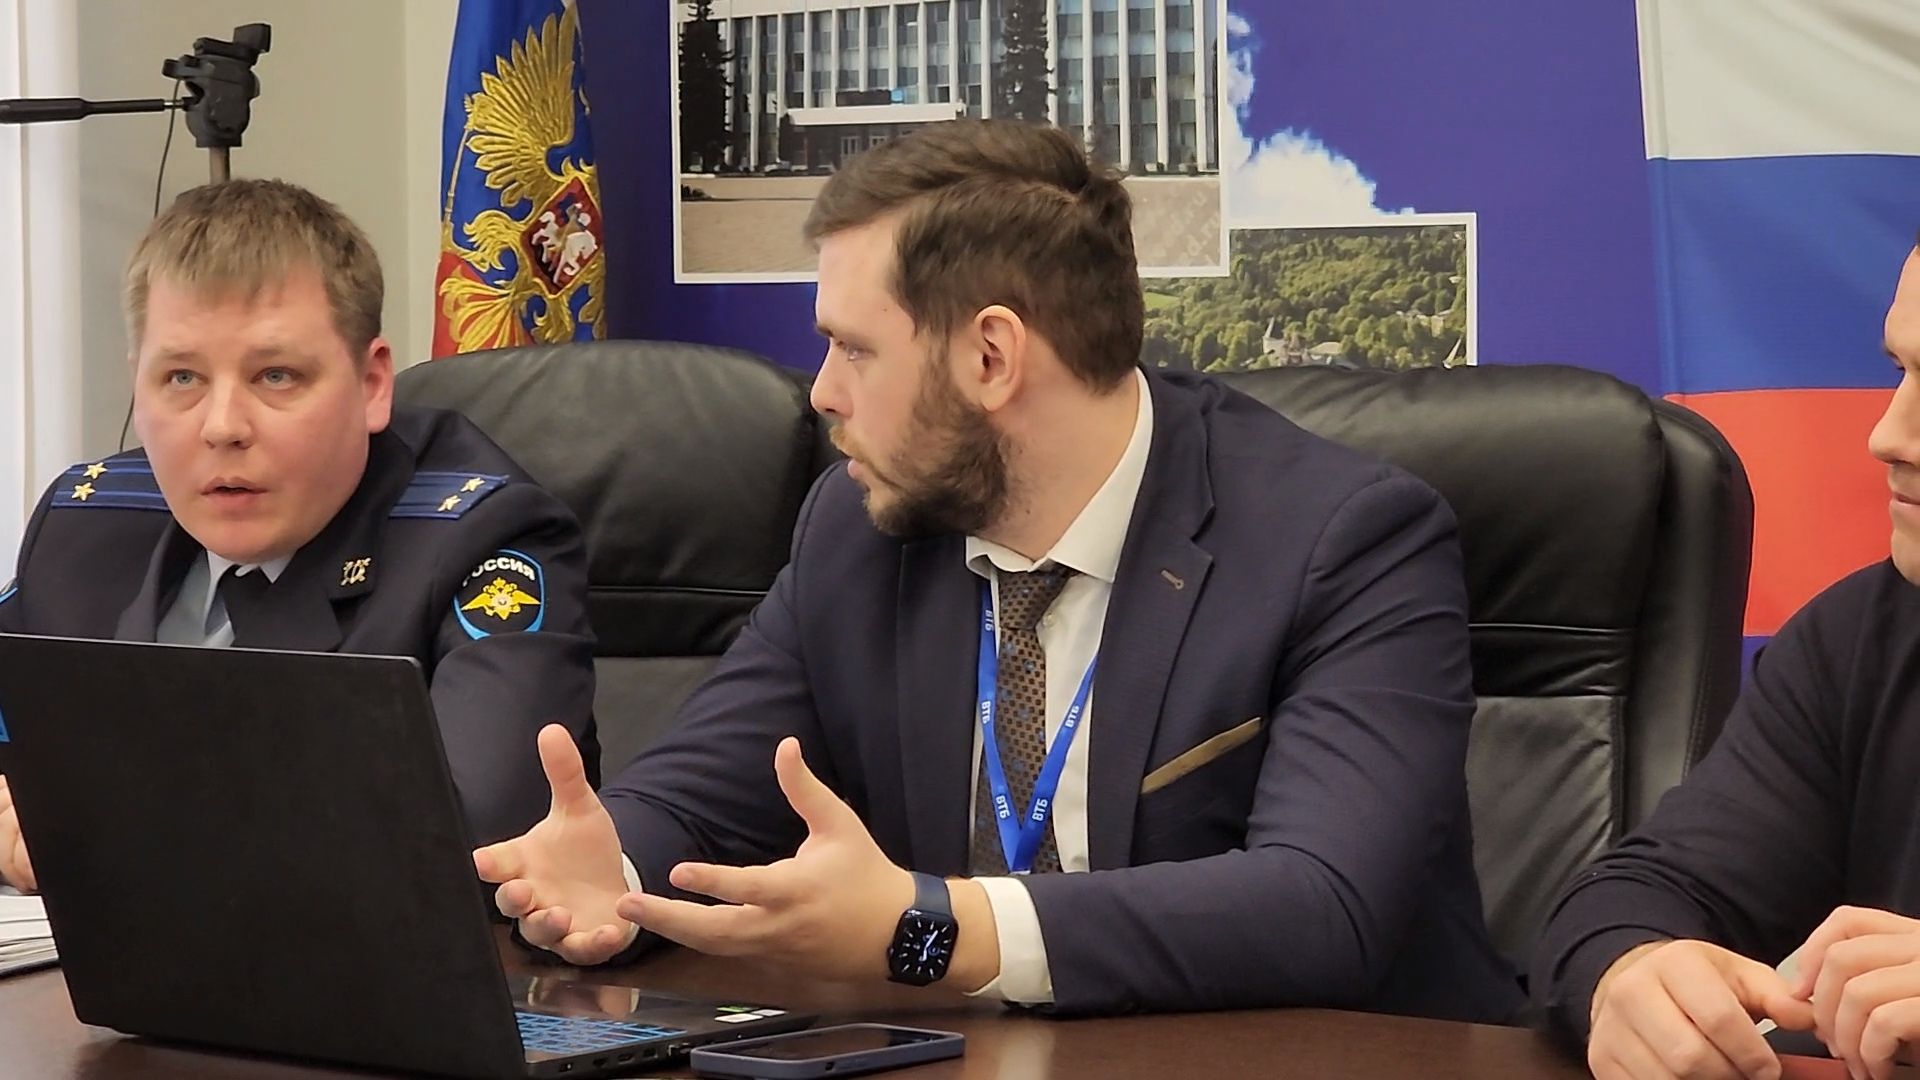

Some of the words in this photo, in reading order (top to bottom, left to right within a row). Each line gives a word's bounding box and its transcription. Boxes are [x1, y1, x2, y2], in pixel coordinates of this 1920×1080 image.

[462, 557, 536, 588] ОССИЯ
[981, 701, 991, 724] ВТБ
[1065, 705, 1080, 728] ВТБ
[995, 795, 1010, 819] ВТБ
[1031, 798, 1048, 821] ВТБ
